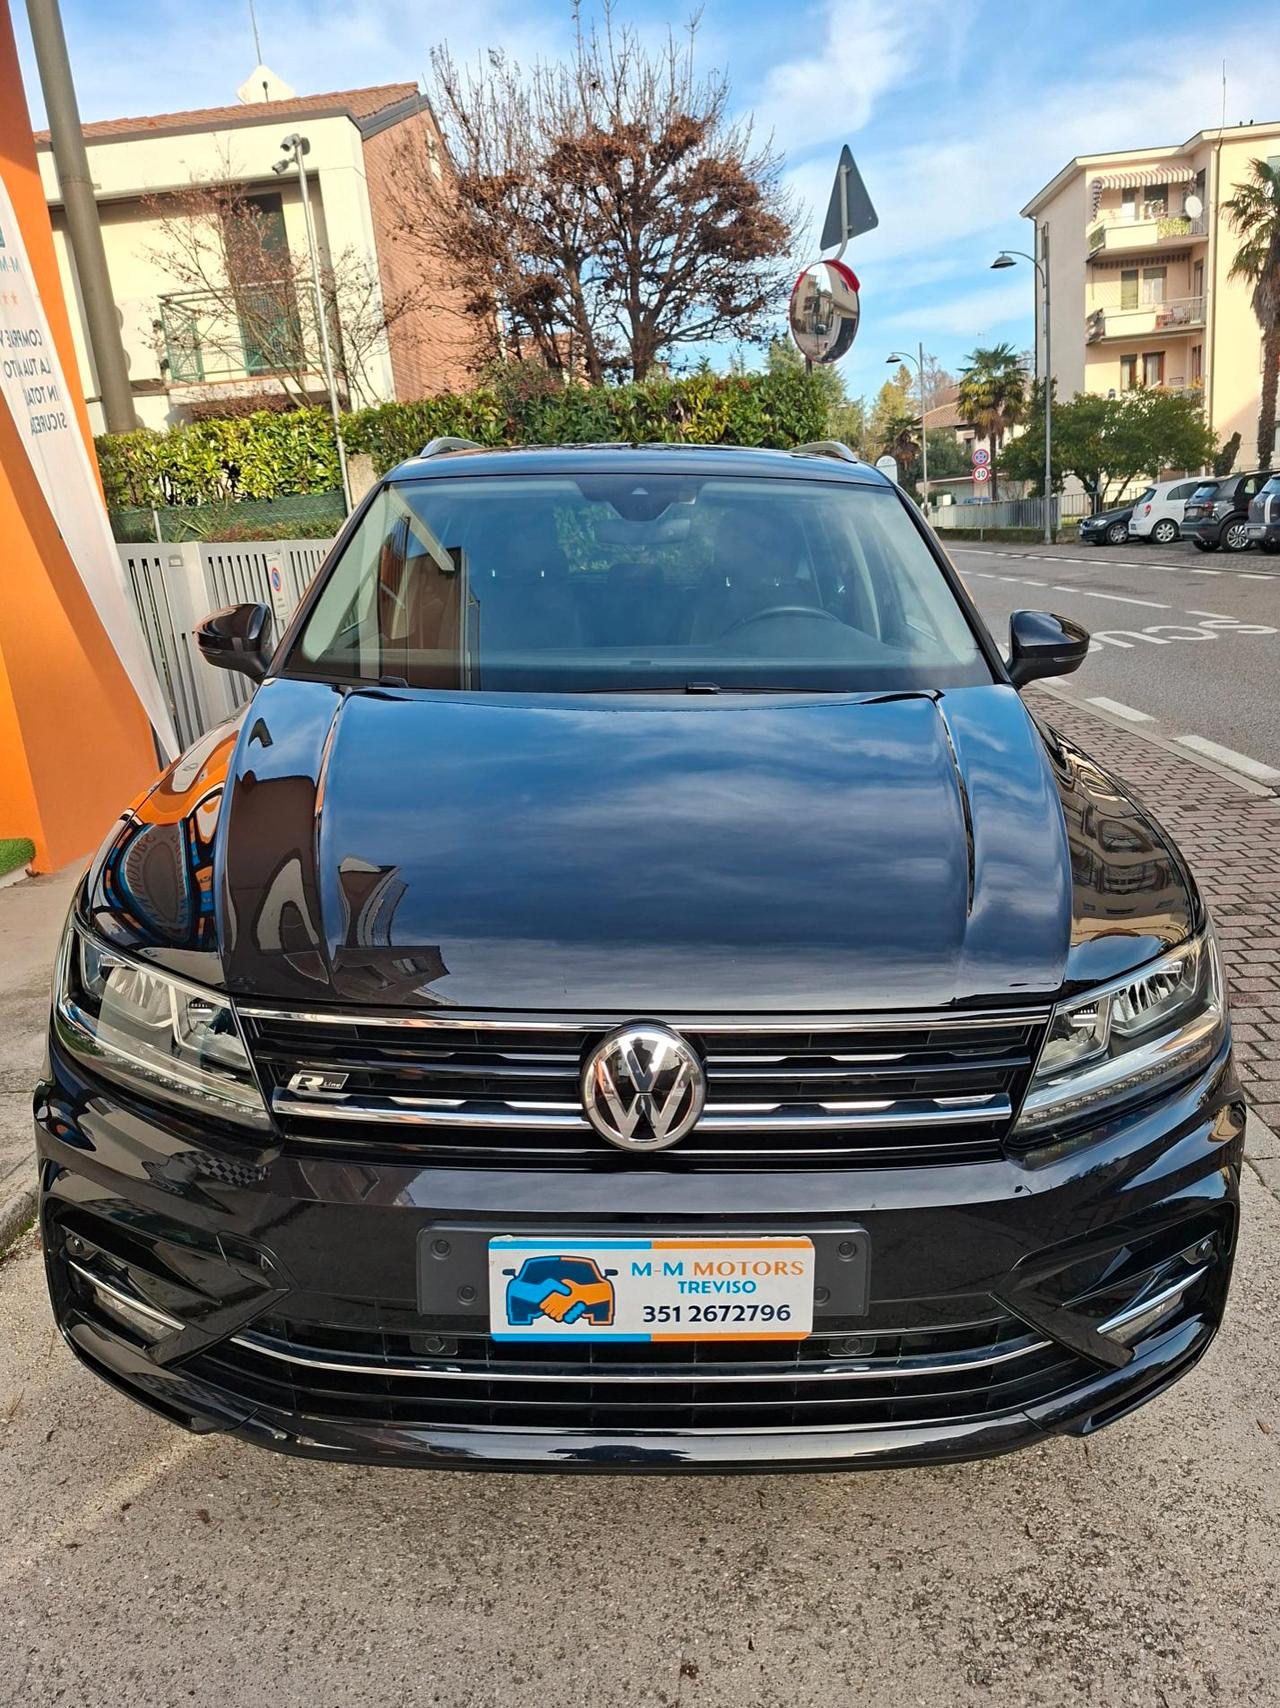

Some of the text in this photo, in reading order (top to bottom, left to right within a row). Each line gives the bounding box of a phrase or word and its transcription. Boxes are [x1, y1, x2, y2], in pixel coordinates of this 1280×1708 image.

[287, 1073, 325, 1092] R
[630, 1259, 806, 1277] M-M MOTORS
[677, 1280, 757, 1294] TREVISO
[642, 1303, 792, 1323] 351 2672796
